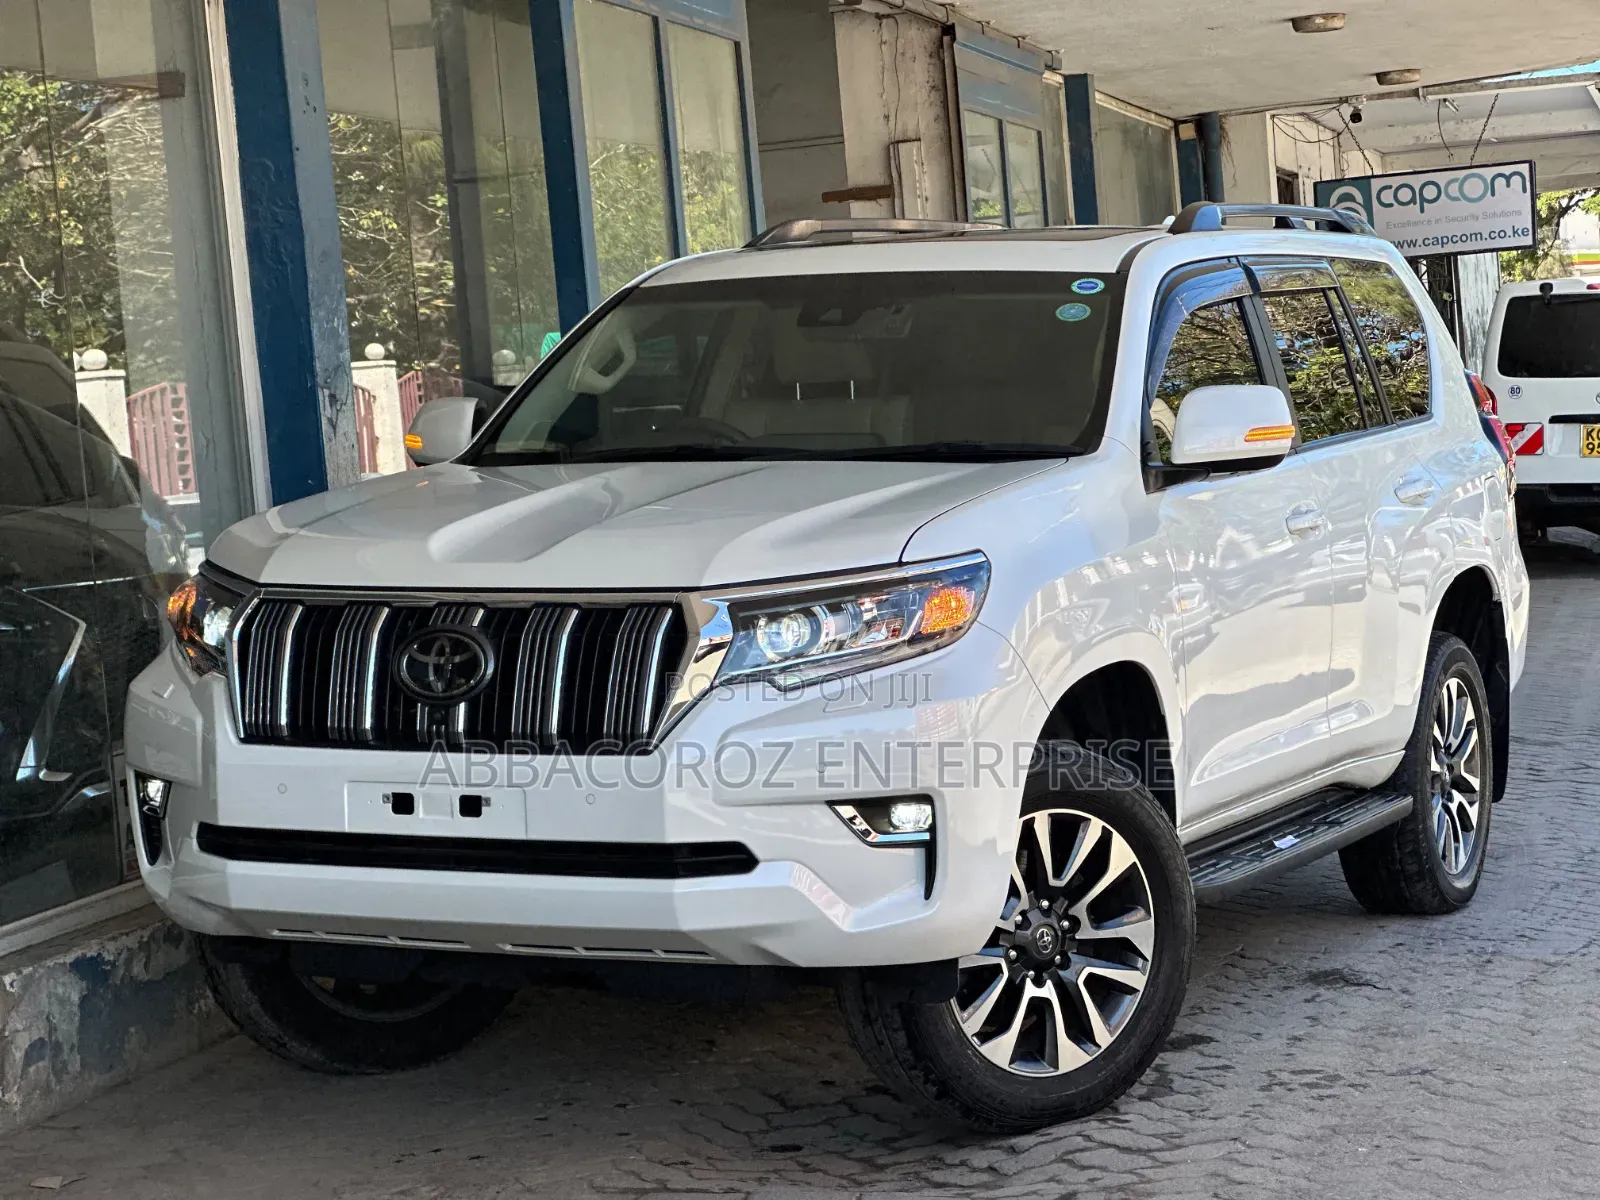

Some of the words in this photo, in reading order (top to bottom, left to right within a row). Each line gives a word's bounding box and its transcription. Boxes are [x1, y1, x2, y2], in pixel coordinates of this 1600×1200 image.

[1376, 171, 1527, 214] capcom
[1386, 219, 1432, 230] Excellence
[1434, 216, 1442, 225] in
[1445, 212, 1480, 224] Security
[1482, 209, 1522, 220] Solutions
[1390, 225, 1530, 250] ww.capcom.co.ke
[1510, 386, 1521, 395] 80
